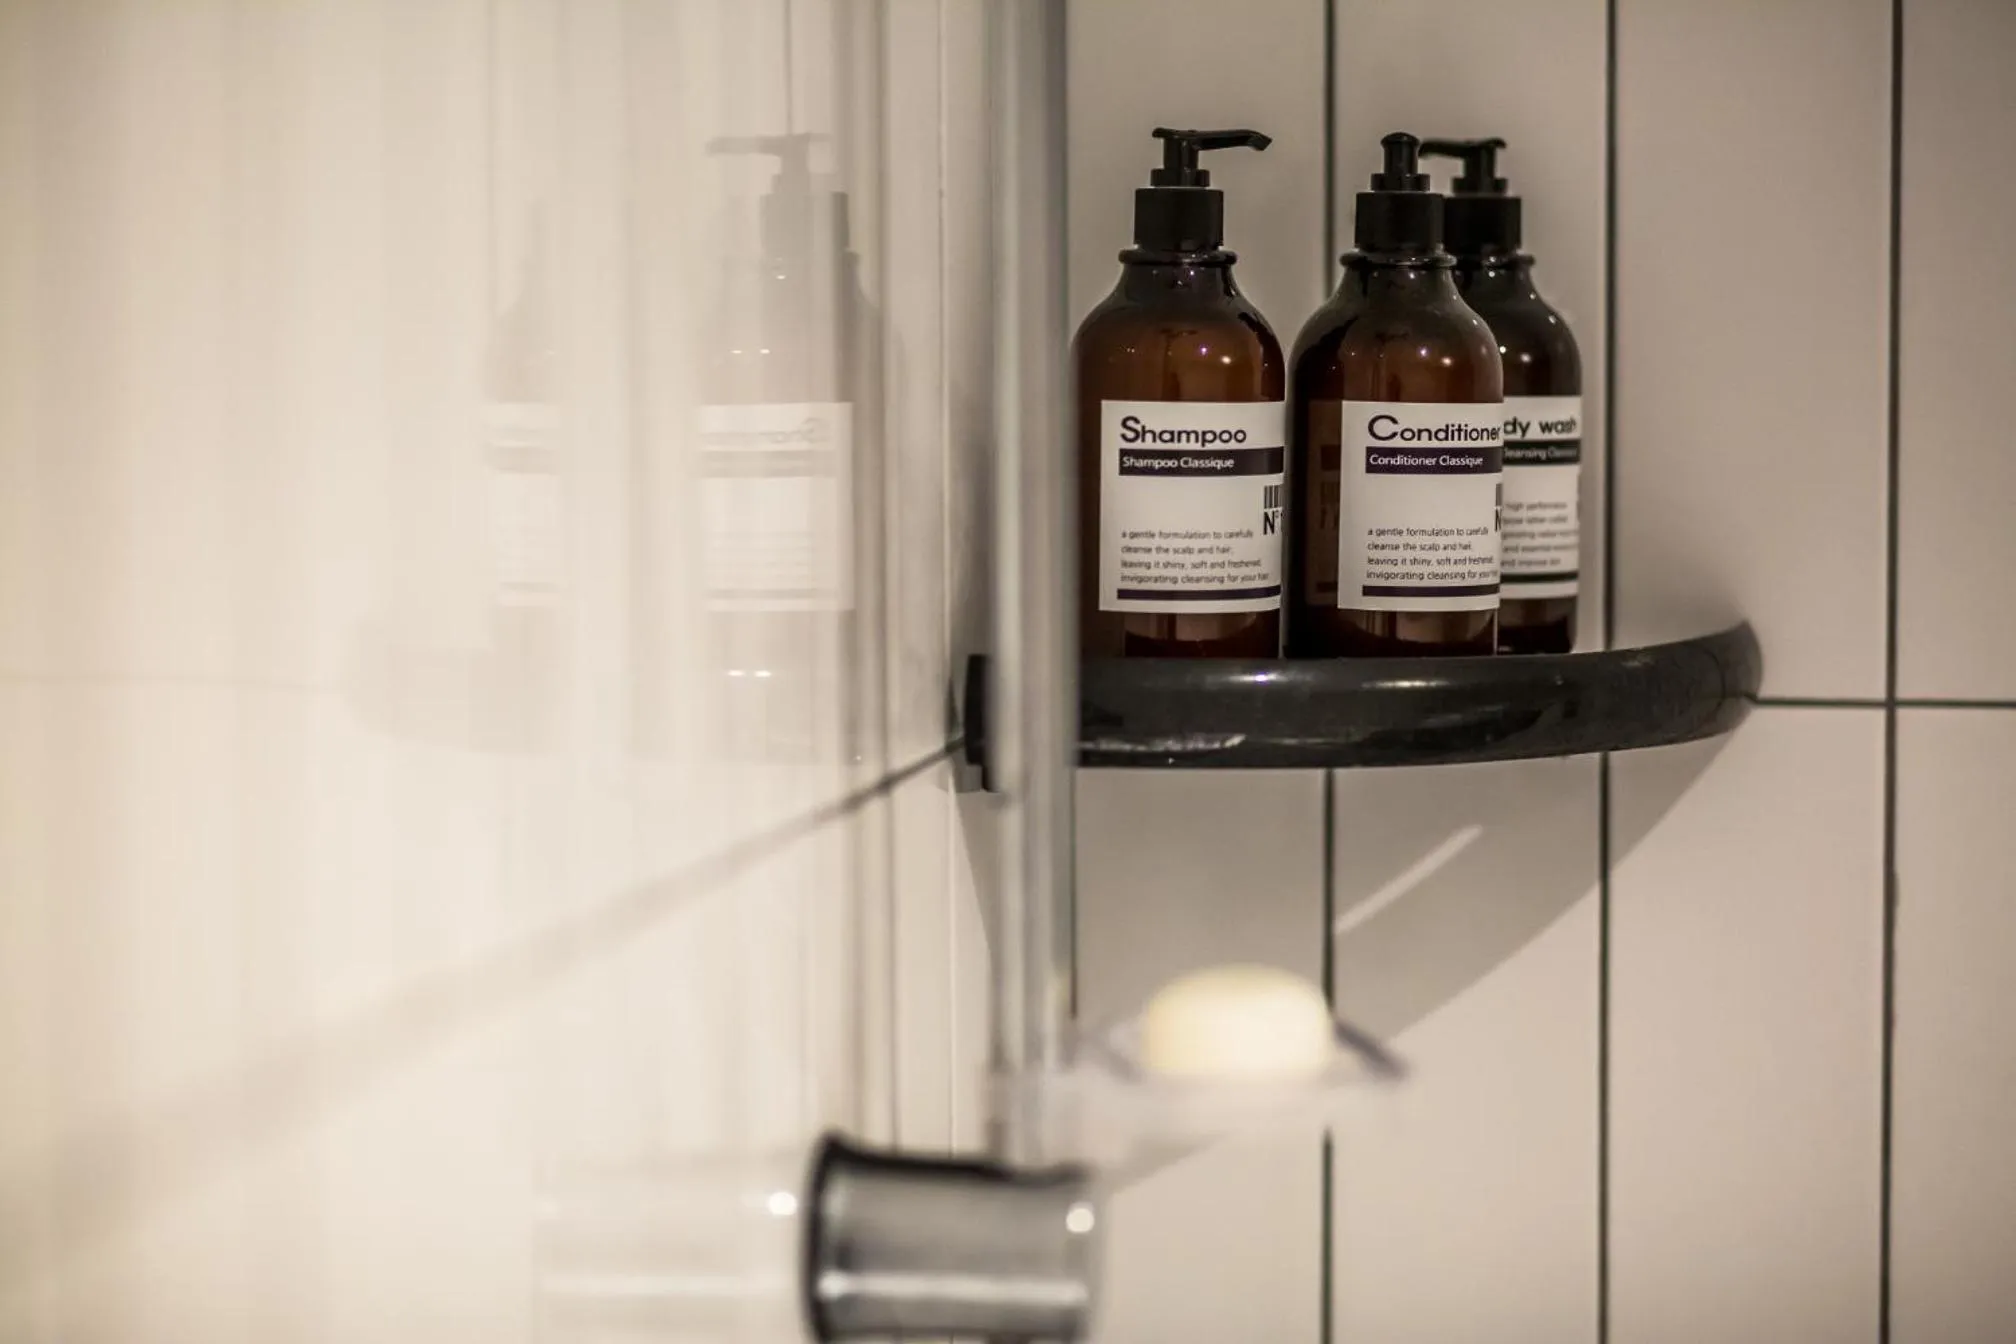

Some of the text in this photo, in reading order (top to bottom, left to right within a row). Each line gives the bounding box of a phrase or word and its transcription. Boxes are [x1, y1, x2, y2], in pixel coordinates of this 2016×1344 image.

[1120, 415, 1248, 448] Shampoo
[1367, 414, 1500, 442] Conditioner
[1503, 415, 1577, 439] dy wash
[1122, 455, 1235, 471] Shampoo Classique
[1369, 454, 1484, 468] Conditioner Classique
[1128, 529, 1156, 540] gentle
[1158, 528, 1212, 540] formulation
[1213, 530, 1222, 539] to
[1367, 528, 1373, 536] a
[1375, 527, 1404, 538] gentle
[1405, 527, 1455, 537] formulation
[1456, 527, 1465, 537] to
[1120, 544, 1153, 555] cleanse
[1154, 544, 1170, 555] the
[1171, 545, 1195, 556] scalp
[1197, 545, 1214, 555] and
[1367, 541, 1401, 551] cleanse
[1402, 542, 1418, 551] the
[1419, 542, 1440, 552] scalp
[1442, 542, 1457, 552] and
[1120, 559, 1152, 571] leaving
[1153, 559, 1161, 569] it
[1190, 558, 1208, 569] soft
[1209, 559, 1226, 570] and
[1367, 556, 1399, 567] leaving
[1401, 557, 1407, 566] it
[1436, 555, 1452, 566] soft
[1453, 555, 1467, 566] and
[1120, 572, 1179, 586] invigorating
[1180, 573, 1225, 585] cleansing
[1227, 572, 1240, 583] for
[1366, 570, 1425, 582] invigorating
[1426, 570, 1466, 581] cleansing
[1467, 569, 1478, 580] for
